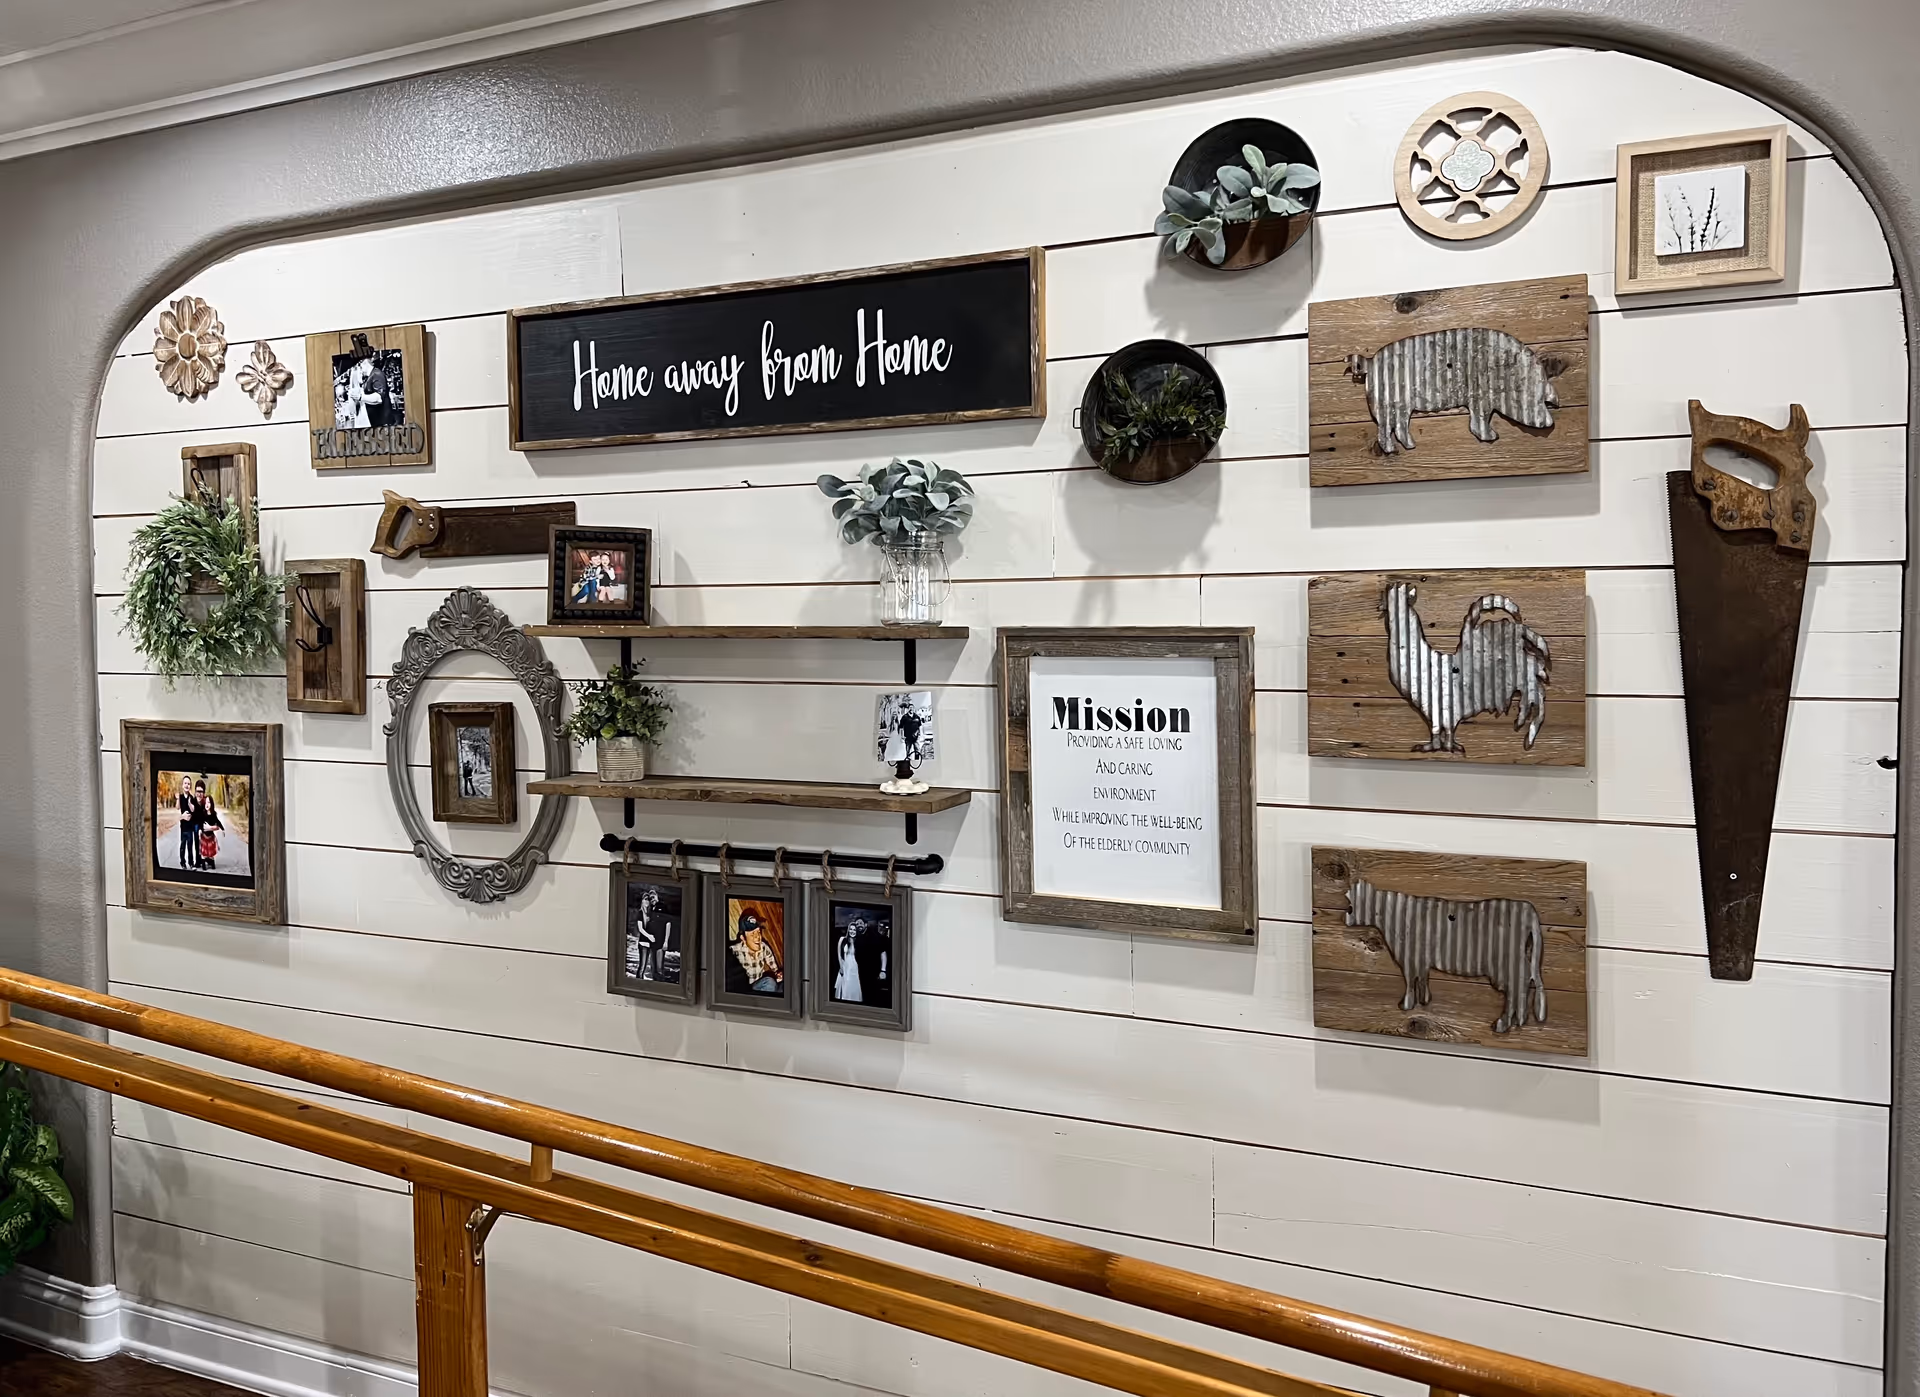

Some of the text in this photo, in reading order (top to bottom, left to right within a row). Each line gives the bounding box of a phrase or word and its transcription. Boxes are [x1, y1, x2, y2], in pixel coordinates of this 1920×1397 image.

[573, 308, 953, 417] Home away from Home
[1051, 696, 1191, 733] Mission
[1067, 732, 1183, 751] PROVIDING A SAFE LOVING
[1118, 762, 1153, 776] CARING
[1093, 786, 1157, 802] ENVIRONMENT
[1081, 811, 1129, 827] IMPROVING
[1131, 814, 1149, 827] THE
[1150, 815, 1203, 831] WELL-BEING
[1078, 836, 1095, 850] THE
[1097, 837, 1133, 852] ELDERLY
[1135, 839, 1191, 856] COMMUNITY
